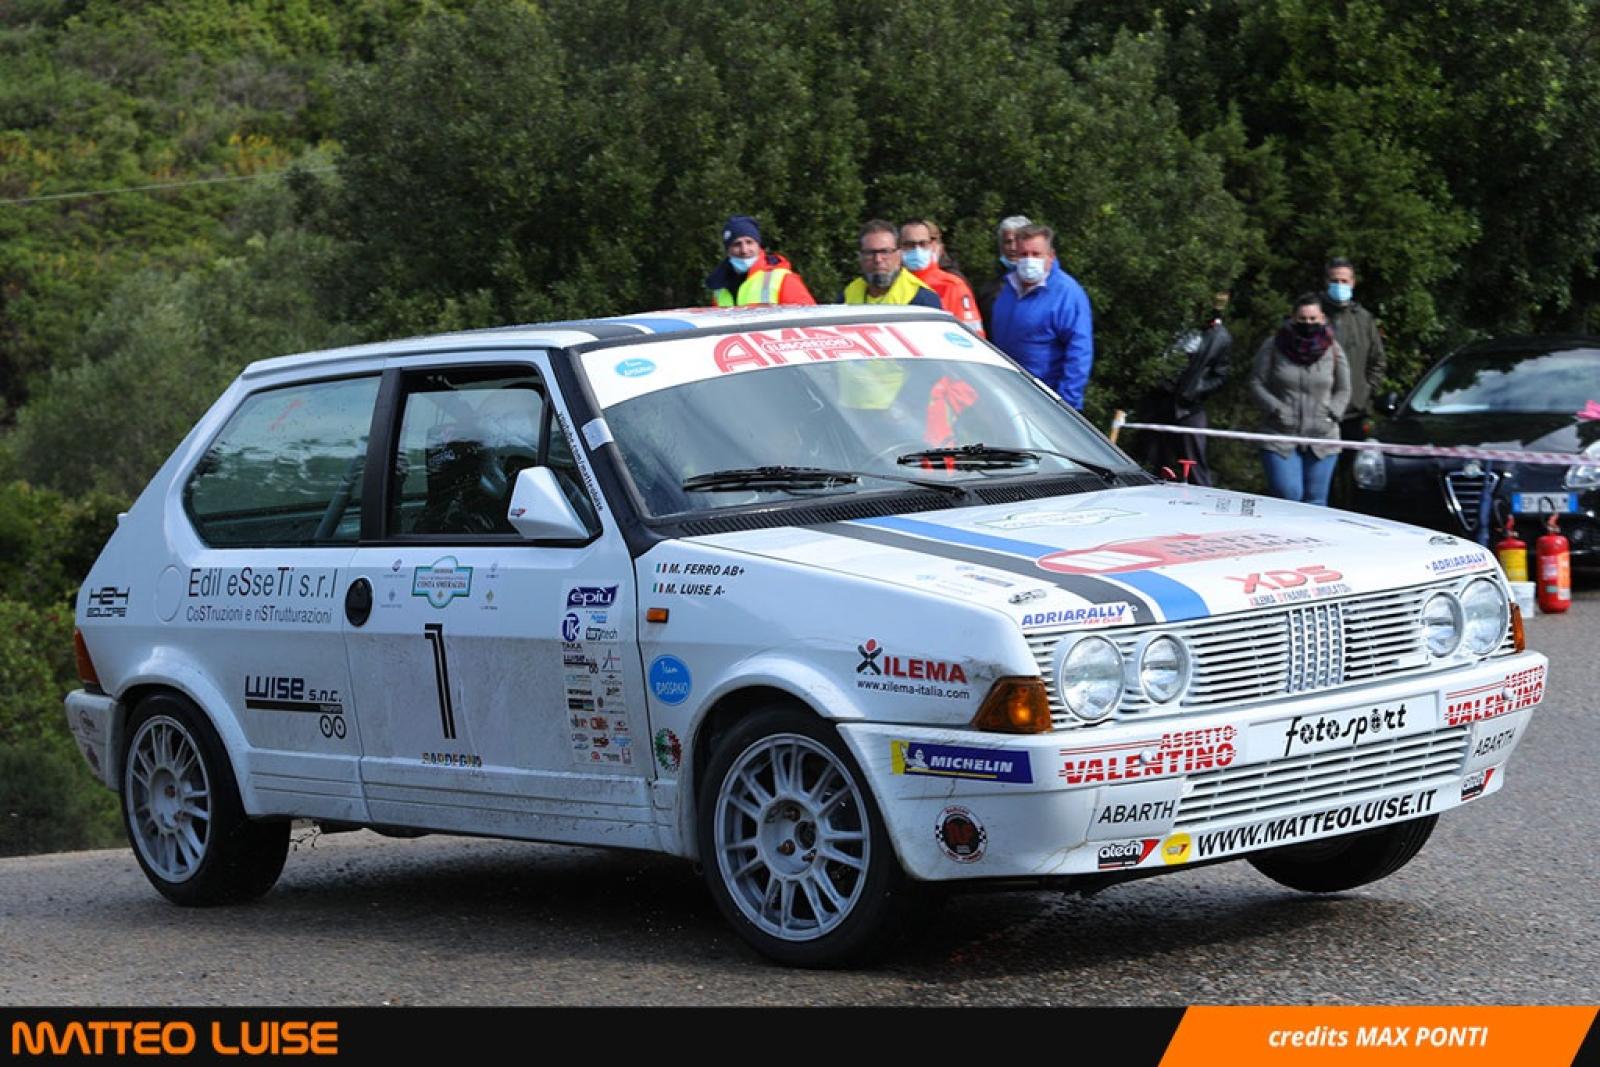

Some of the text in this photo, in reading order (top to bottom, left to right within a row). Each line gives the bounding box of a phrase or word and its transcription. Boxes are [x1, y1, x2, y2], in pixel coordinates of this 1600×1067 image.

[669, 563, 745, 576] M. FERRO AB+
[1431, 552, 1487, 571] ADRIARALLY
[188, 566, 338, 599] Edil eSseTi s.r.l
[665, 583, 726, 596] M. LUISE A-
[1224, 565, 1343, 594] XDS
[254, 605, 332, 624] riSTrutturazioni
[1021, 604, 1126, 626] ADRIARALLY
[856, 679, 970, 700] www.xilema-italia.com
[1160, 725, 1236, 750] ASSETTO
[1473, 727, 1517, 758] ABARTH
[930, 755, 1013, 773] MICHELIN
[1060, 743, 1236, 784] VALENTINO
[1098, 799, 1176, 824] ABARTH
[1197, 789, 1438, 858] WWW.MATTEOLUISE.IT
